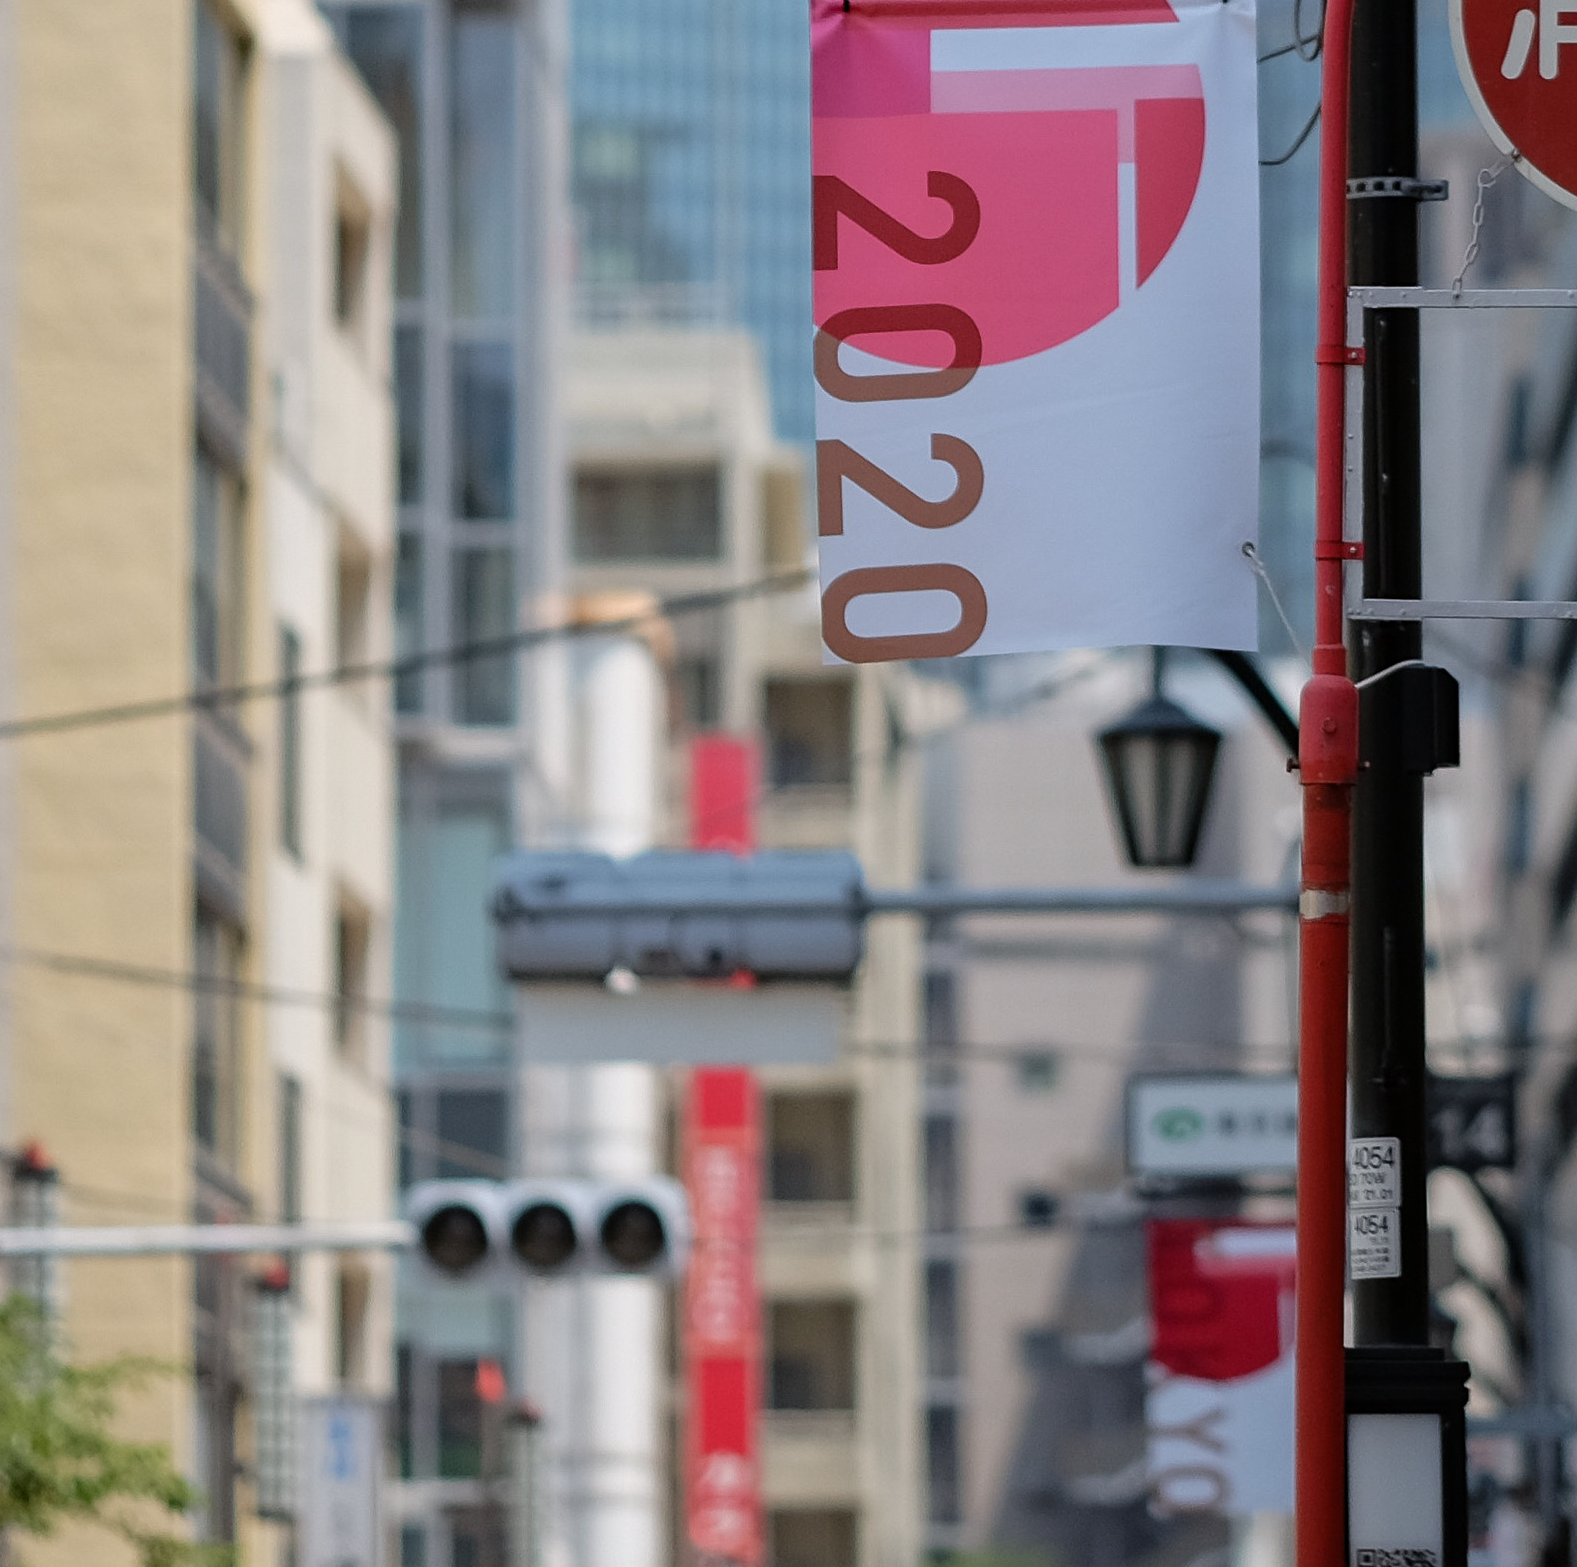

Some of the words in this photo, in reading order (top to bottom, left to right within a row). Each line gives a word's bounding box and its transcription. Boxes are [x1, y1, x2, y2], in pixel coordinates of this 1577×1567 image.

[812, 170, 988, 665] 2020
[1353, 1145, 1396, 1170] 4054
[1354, 1214, 1389, 1235] 4054
